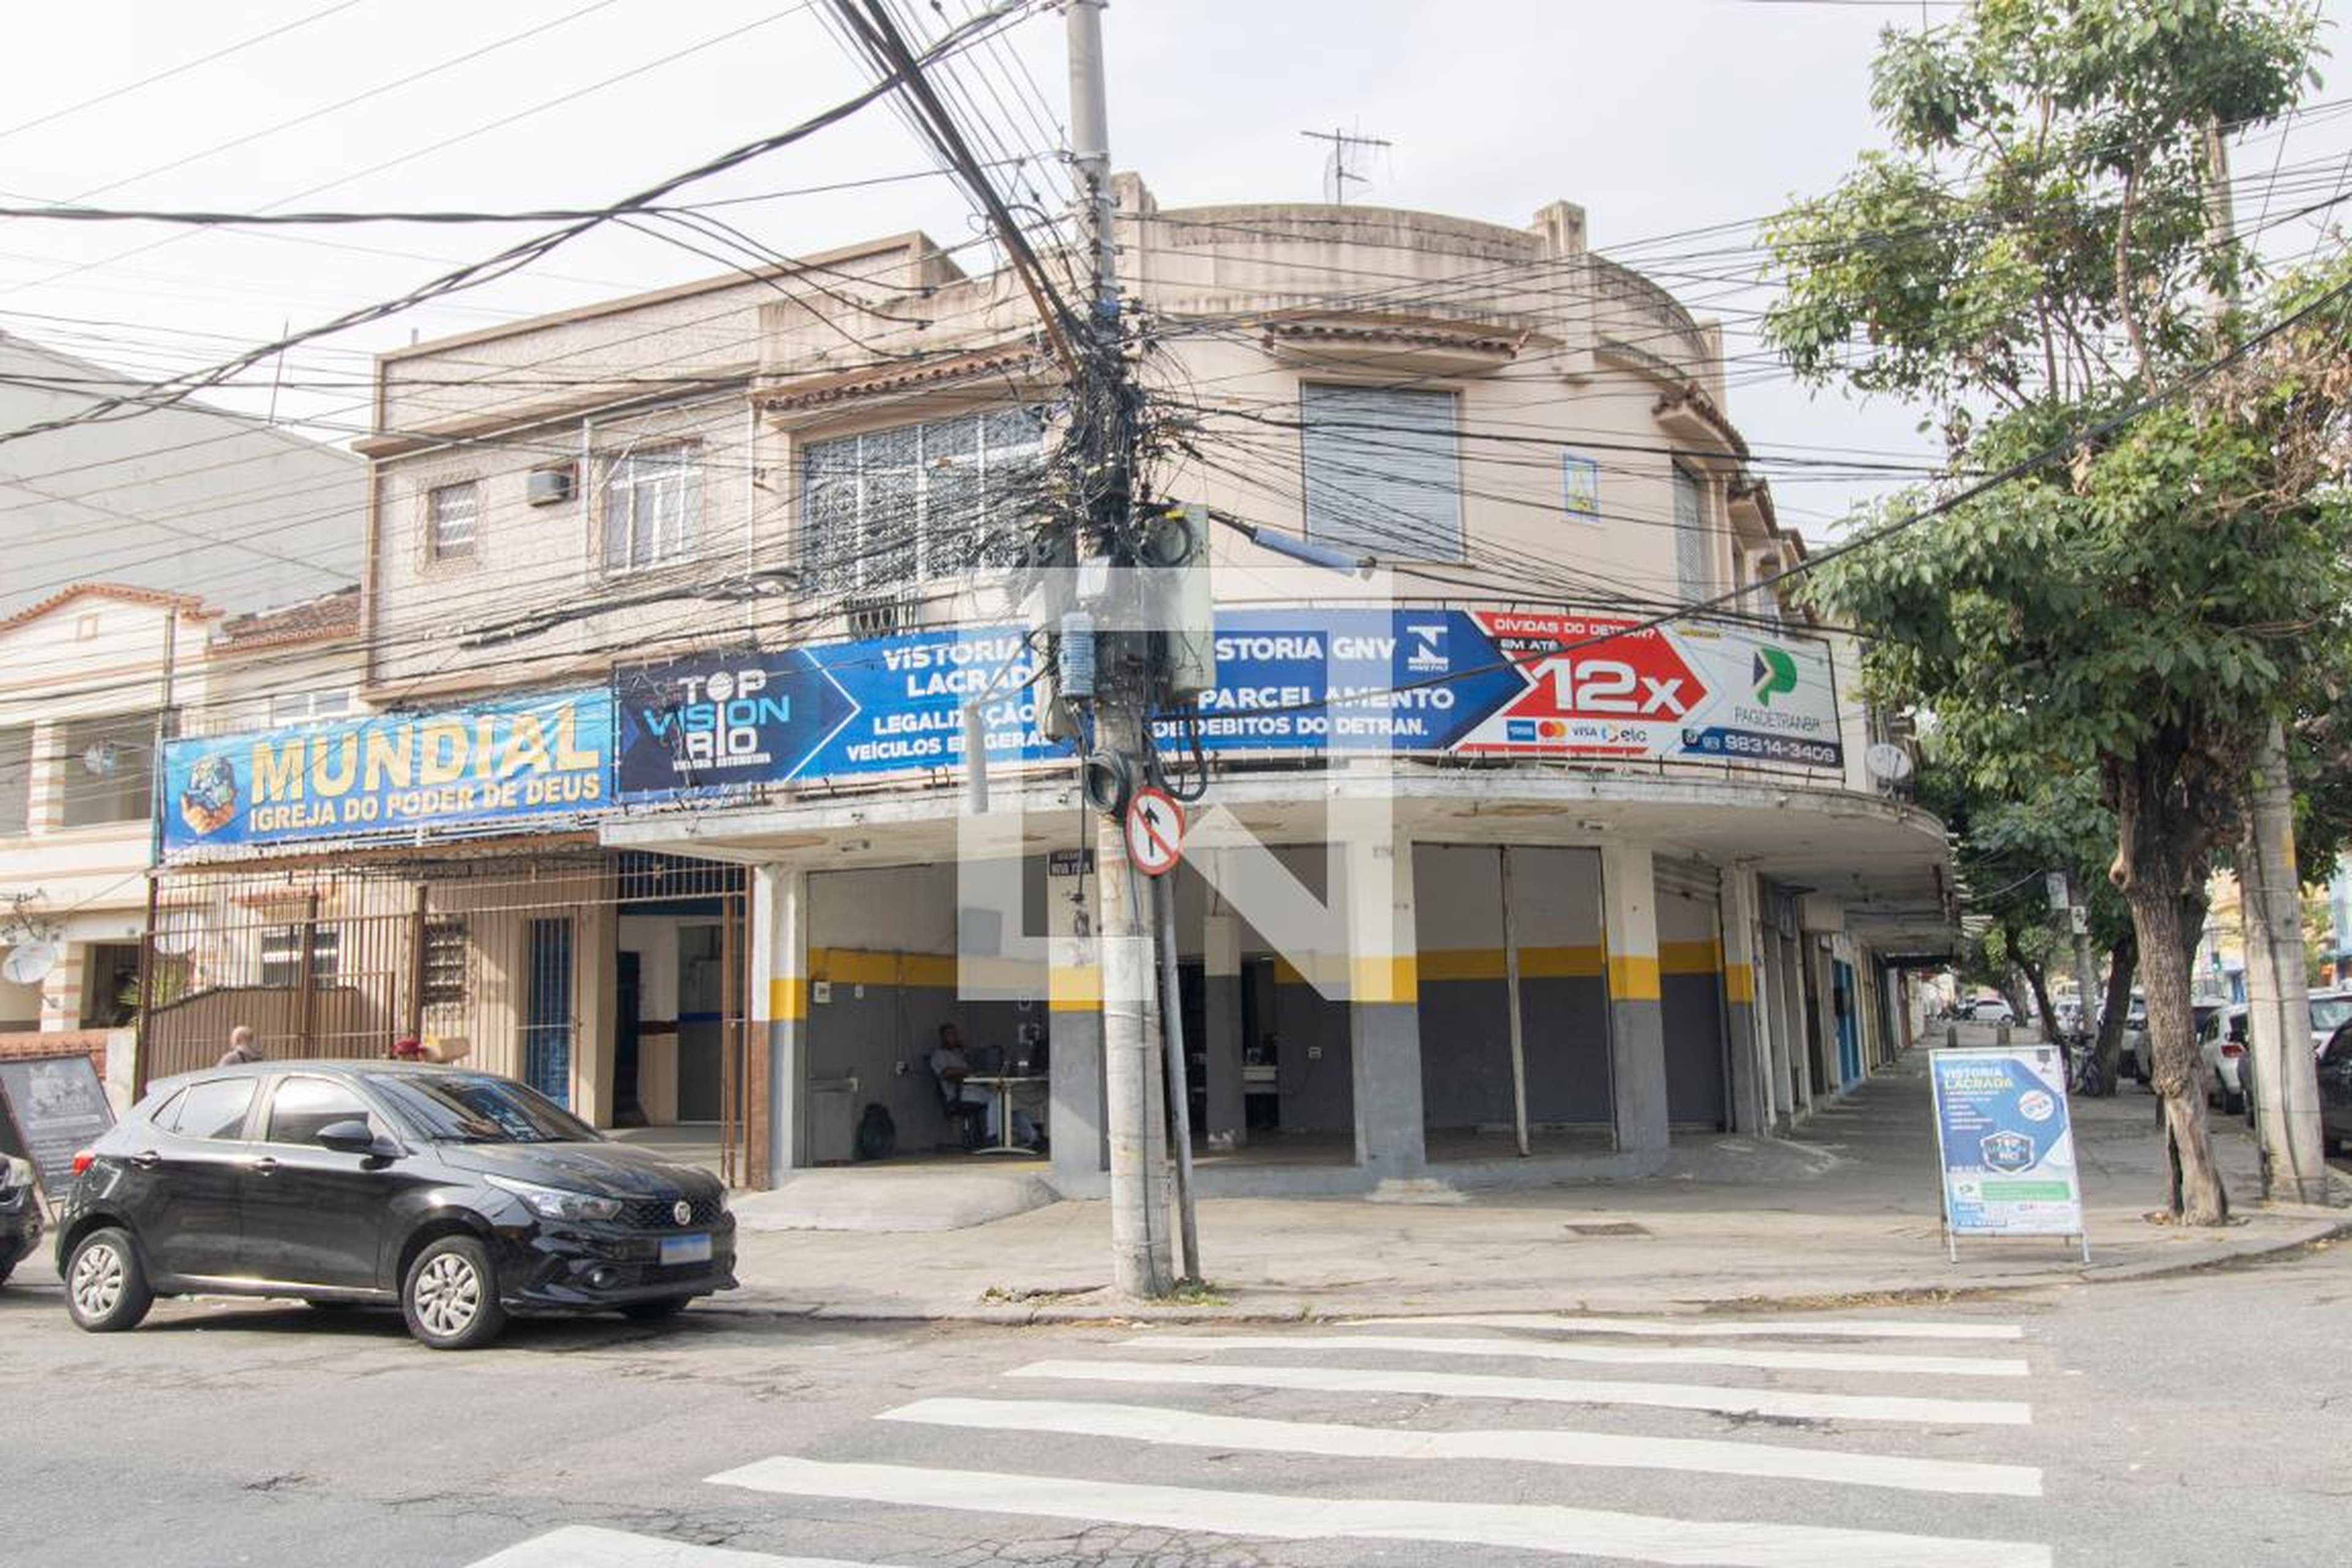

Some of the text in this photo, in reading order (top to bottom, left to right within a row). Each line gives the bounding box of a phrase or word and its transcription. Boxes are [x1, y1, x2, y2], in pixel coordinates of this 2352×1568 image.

[1501, 638, 1525, 650] EM
[1564, 622, 1585, 635] DO
[883, 639, 1025, 671] VISTORIA
[1215, 636, 1397, 661] STORIA GNV
[677, 669, 766, 705] TOP
[907, 665, 1034, 698] LACRAD
[644, 695, 790, 735] VISION
[873, 701, 1035, 735] LEGALIZÇÃO
[1296, 716, 1327, 735] DO
[1338, 718, 1428, 735] DETRAN.
[250, 702, 601, 805] MUNDIAL
[685, 726, 758, 760] RIO
[846, 736, 941, 762] VEÍCULOS
[250, 773, 601, 833] IGREJA DO PODER DE DEUS
